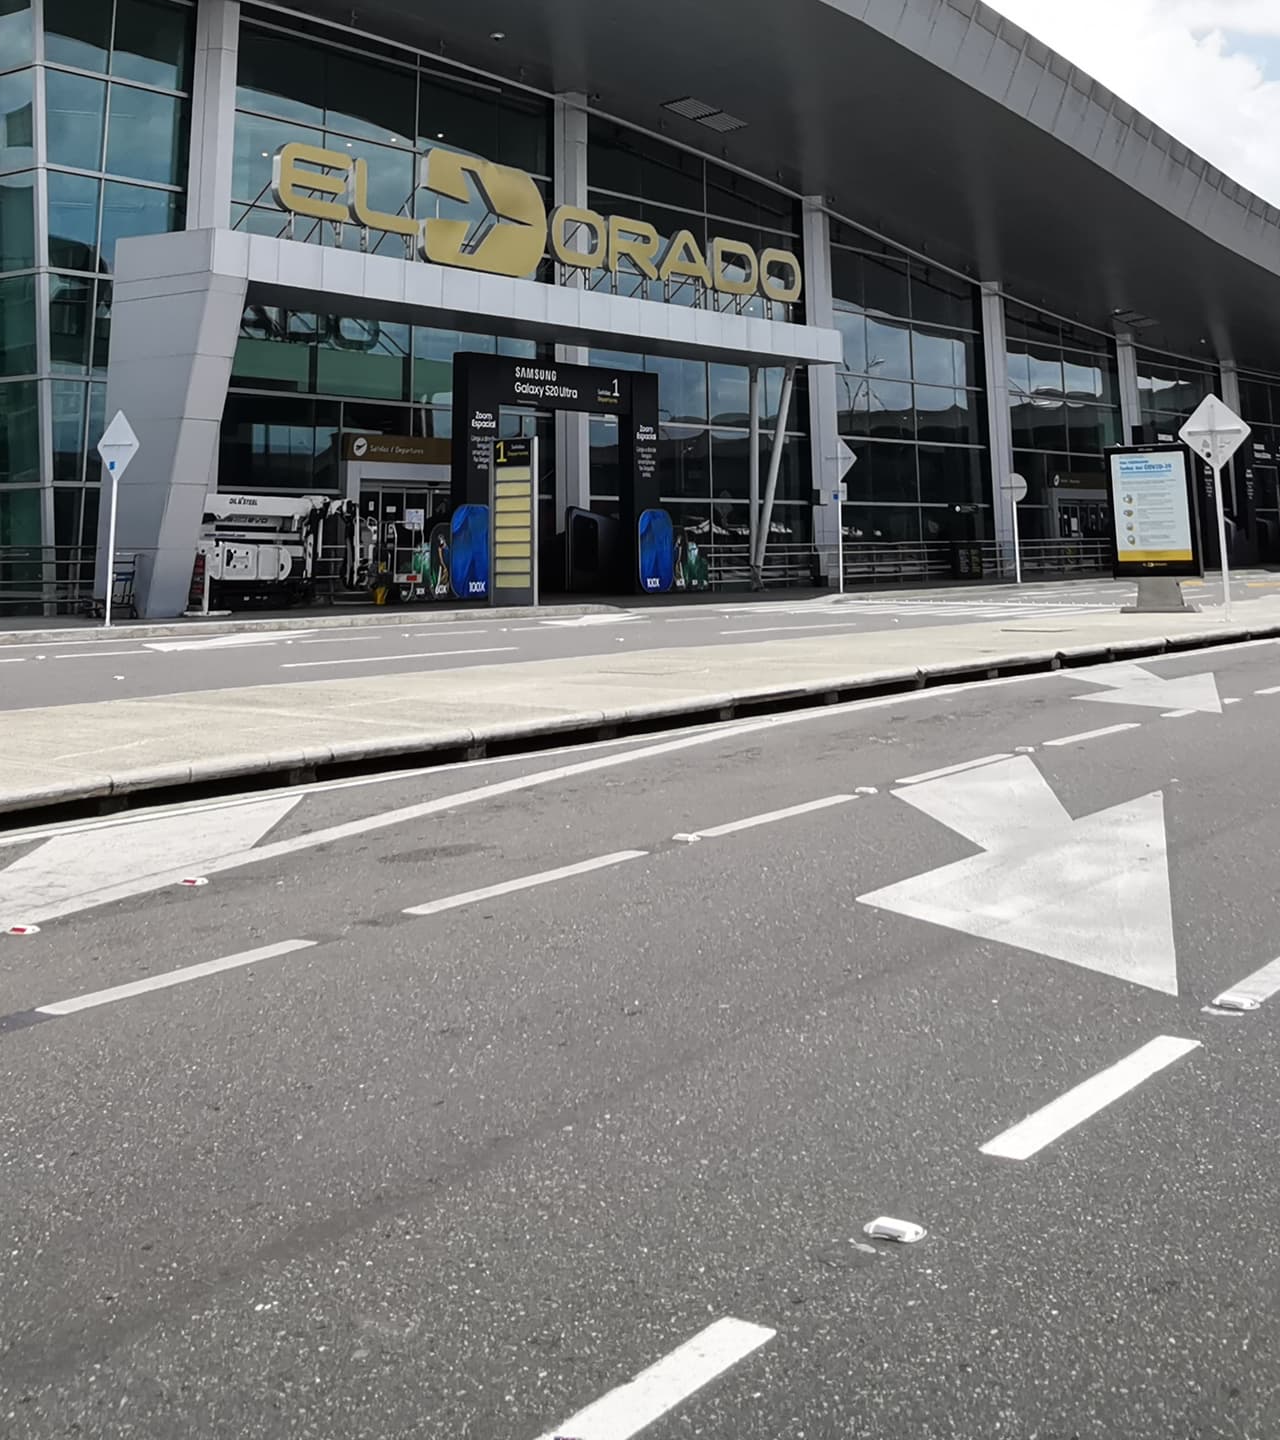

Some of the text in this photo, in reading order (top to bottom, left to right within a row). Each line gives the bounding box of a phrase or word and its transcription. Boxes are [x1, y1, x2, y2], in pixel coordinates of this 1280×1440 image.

[273, 142, 419, 235] EL
[515, 366, 557, 381] SAMSUNG
[514, 382, 578, 399] Galaxy S20 Ultra
[612, 378, 620, 397] 1
[475, 411, 493, 420] Zoom
[471, 419, 496, 430] Espacial
[495, 441, 507, 463] 1
[468, 581, 486, 593] 100X
